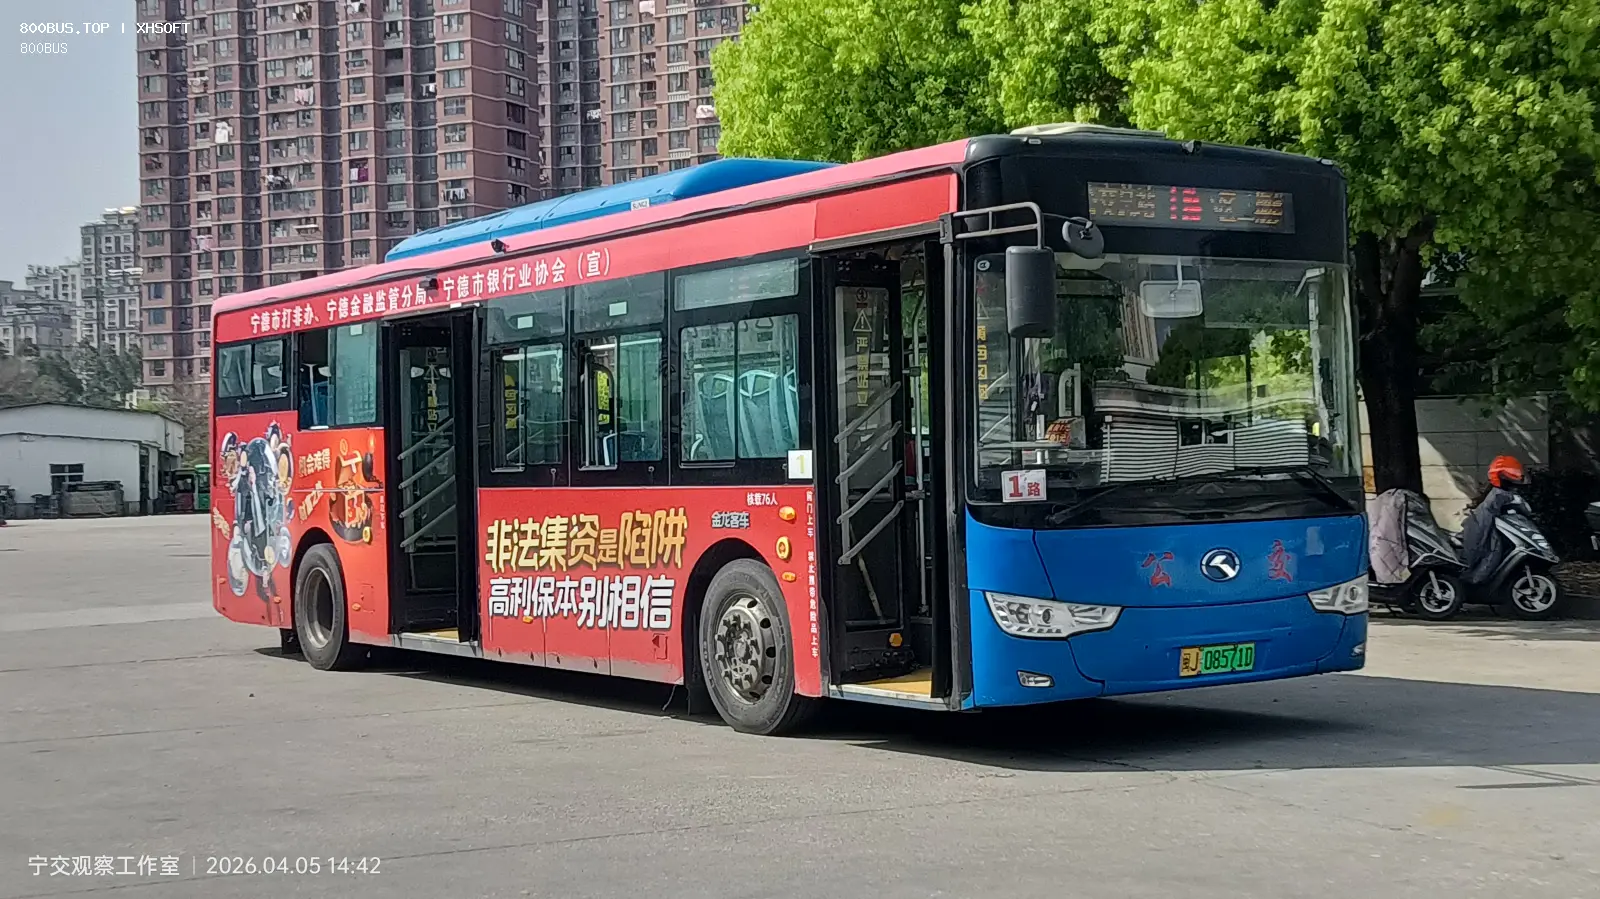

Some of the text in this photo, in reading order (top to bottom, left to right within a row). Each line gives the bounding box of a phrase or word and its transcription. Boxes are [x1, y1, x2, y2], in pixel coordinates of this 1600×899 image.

[747, 492, 778, 506] 核载76人
[711, 510, 750, 529] 金龙客车
[485, 506, 688, 574] 非法集资是陷阱
[488, 574, 676, 630] 高利保本别相信
